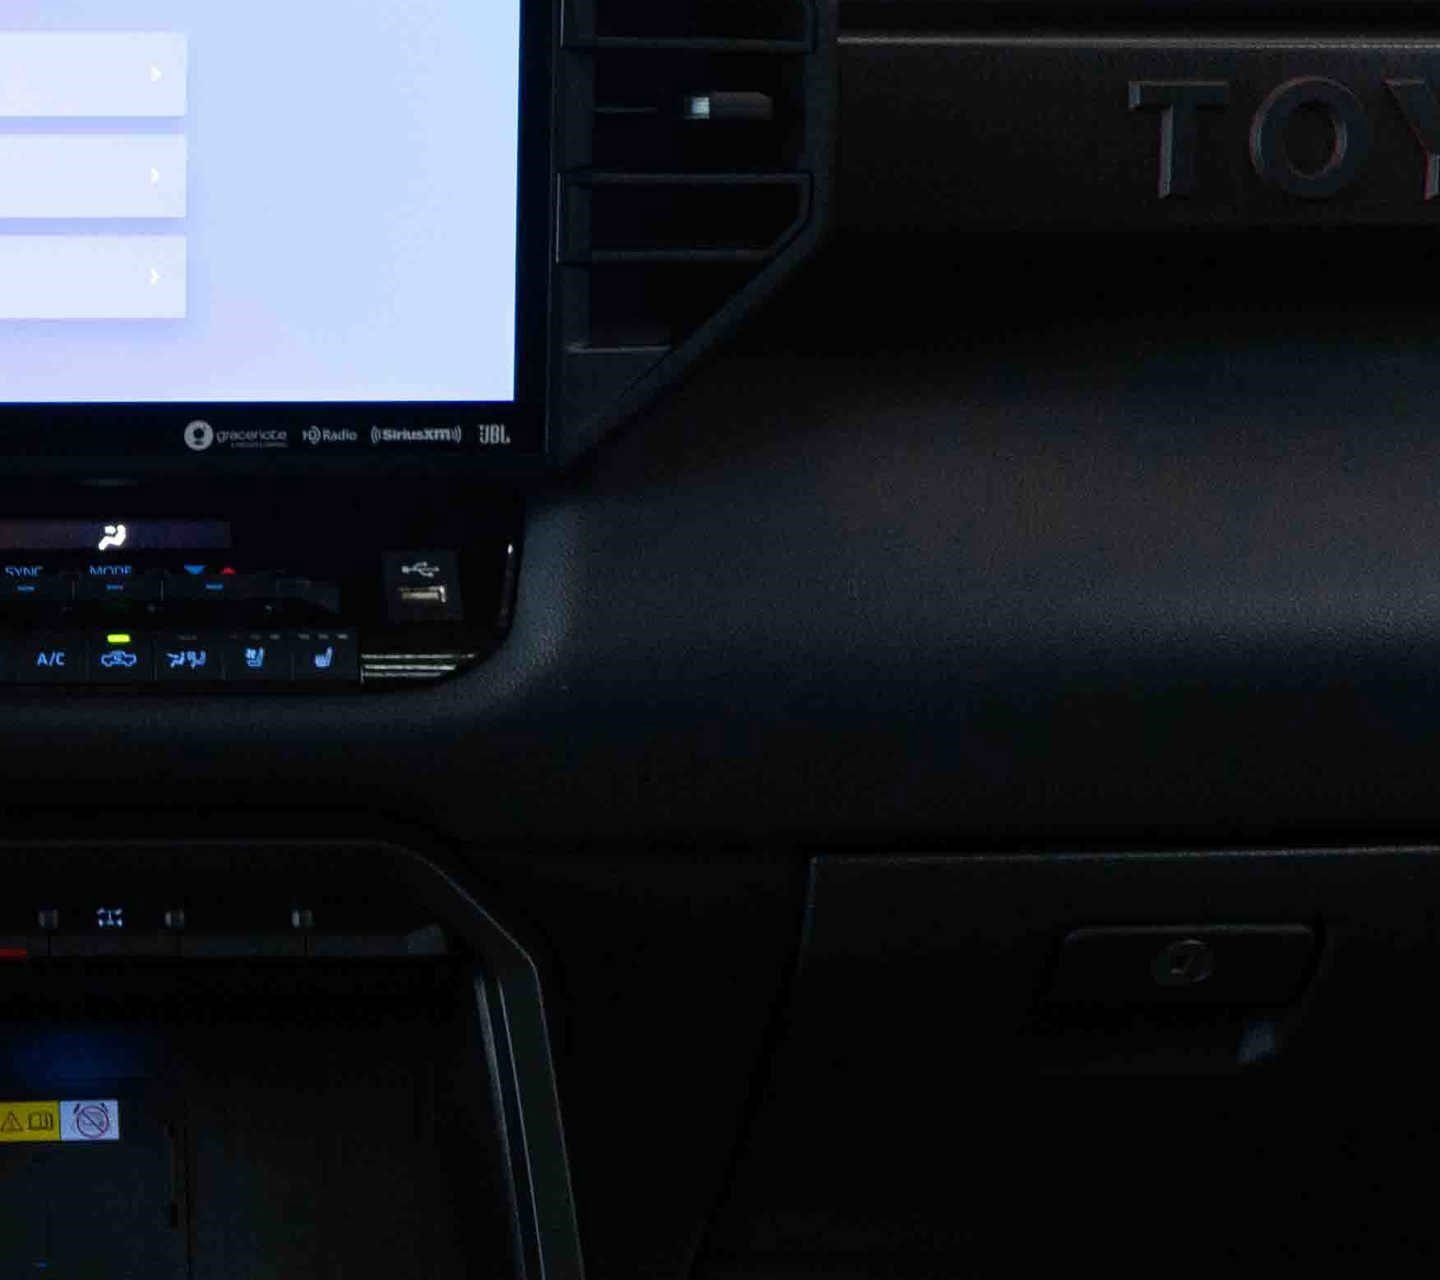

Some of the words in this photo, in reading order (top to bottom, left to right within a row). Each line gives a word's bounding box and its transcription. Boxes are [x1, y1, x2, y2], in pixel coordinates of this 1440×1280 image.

[322, 427, 359, 442] Radio
[480, 424, 512, 445] JBL
[35, 650, 67, 668] A/C
